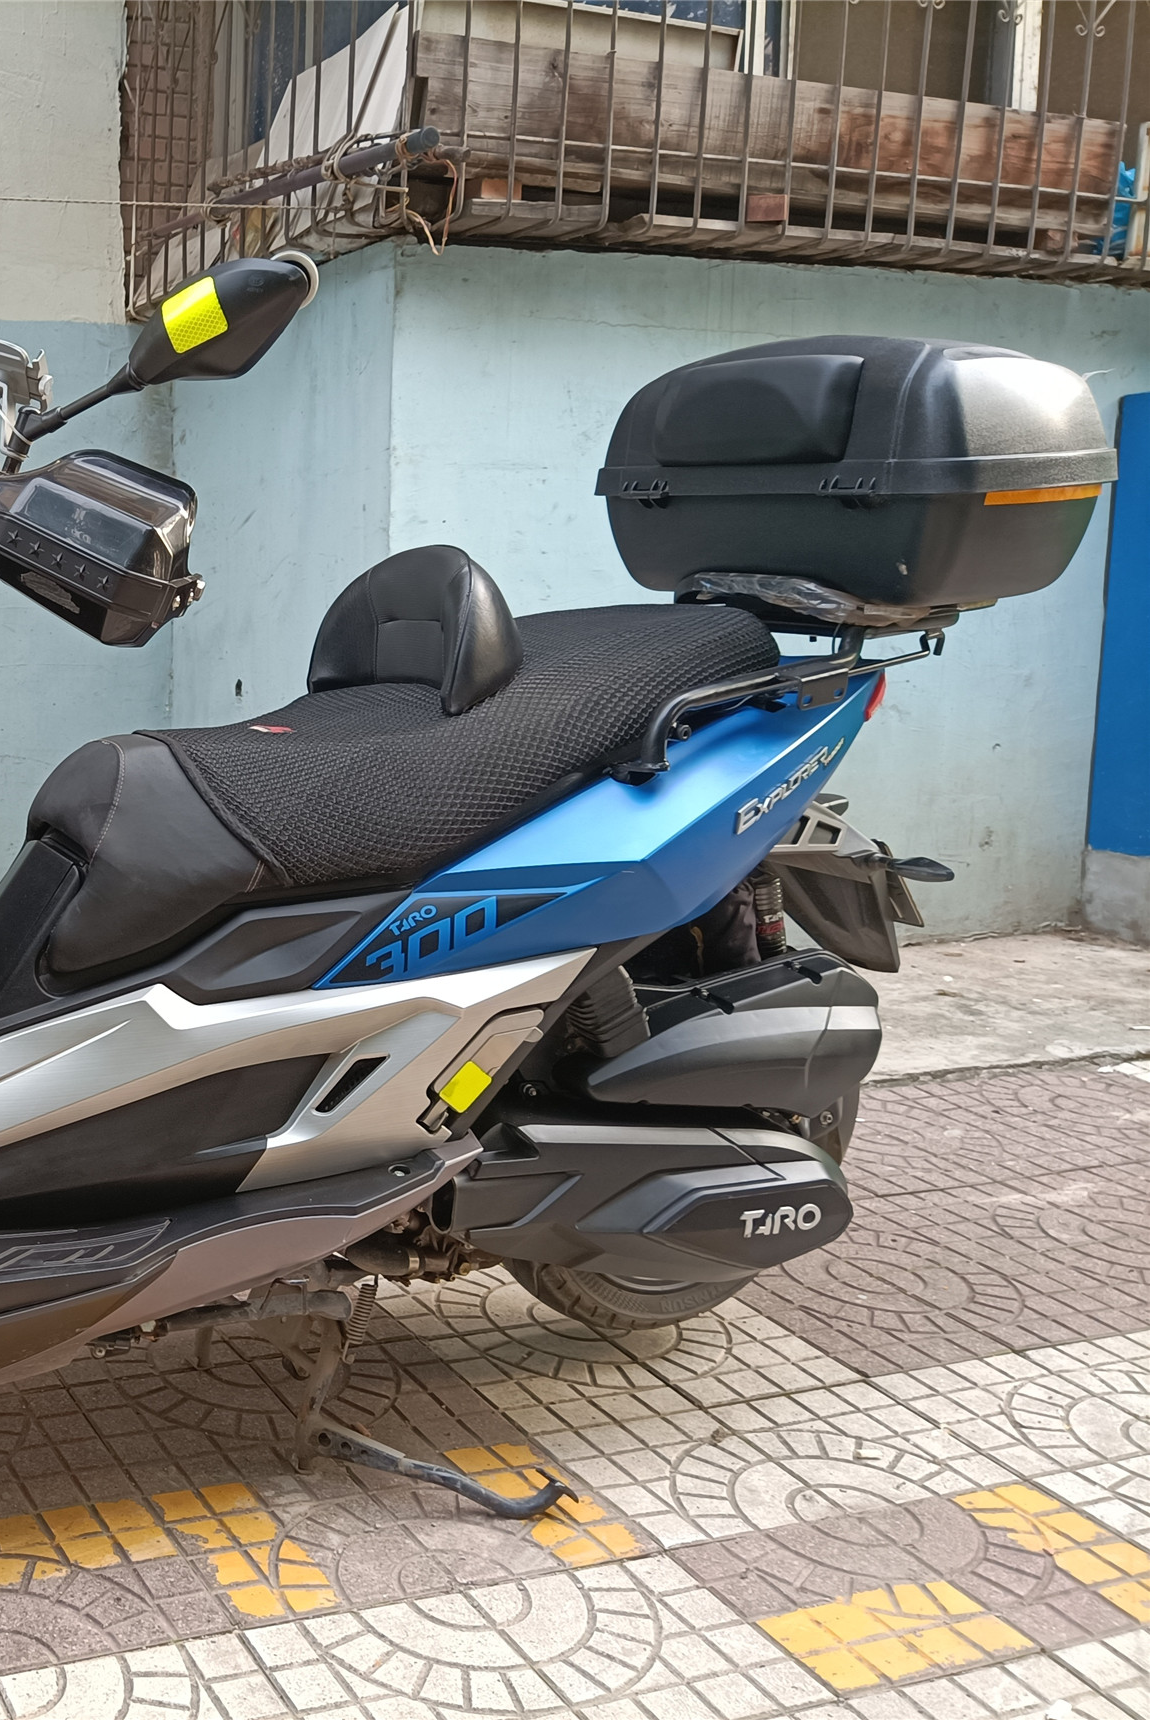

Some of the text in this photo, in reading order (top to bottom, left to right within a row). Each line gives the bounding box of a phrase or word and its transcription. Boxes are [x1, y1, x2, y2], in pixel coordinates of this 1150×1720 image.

[736, 737, 845, 835] EXPLORER
[365, 896, 498, 980] 300
[388, 904, 438, 936] TARO
[739, 1203, 822, 1238] TARO
